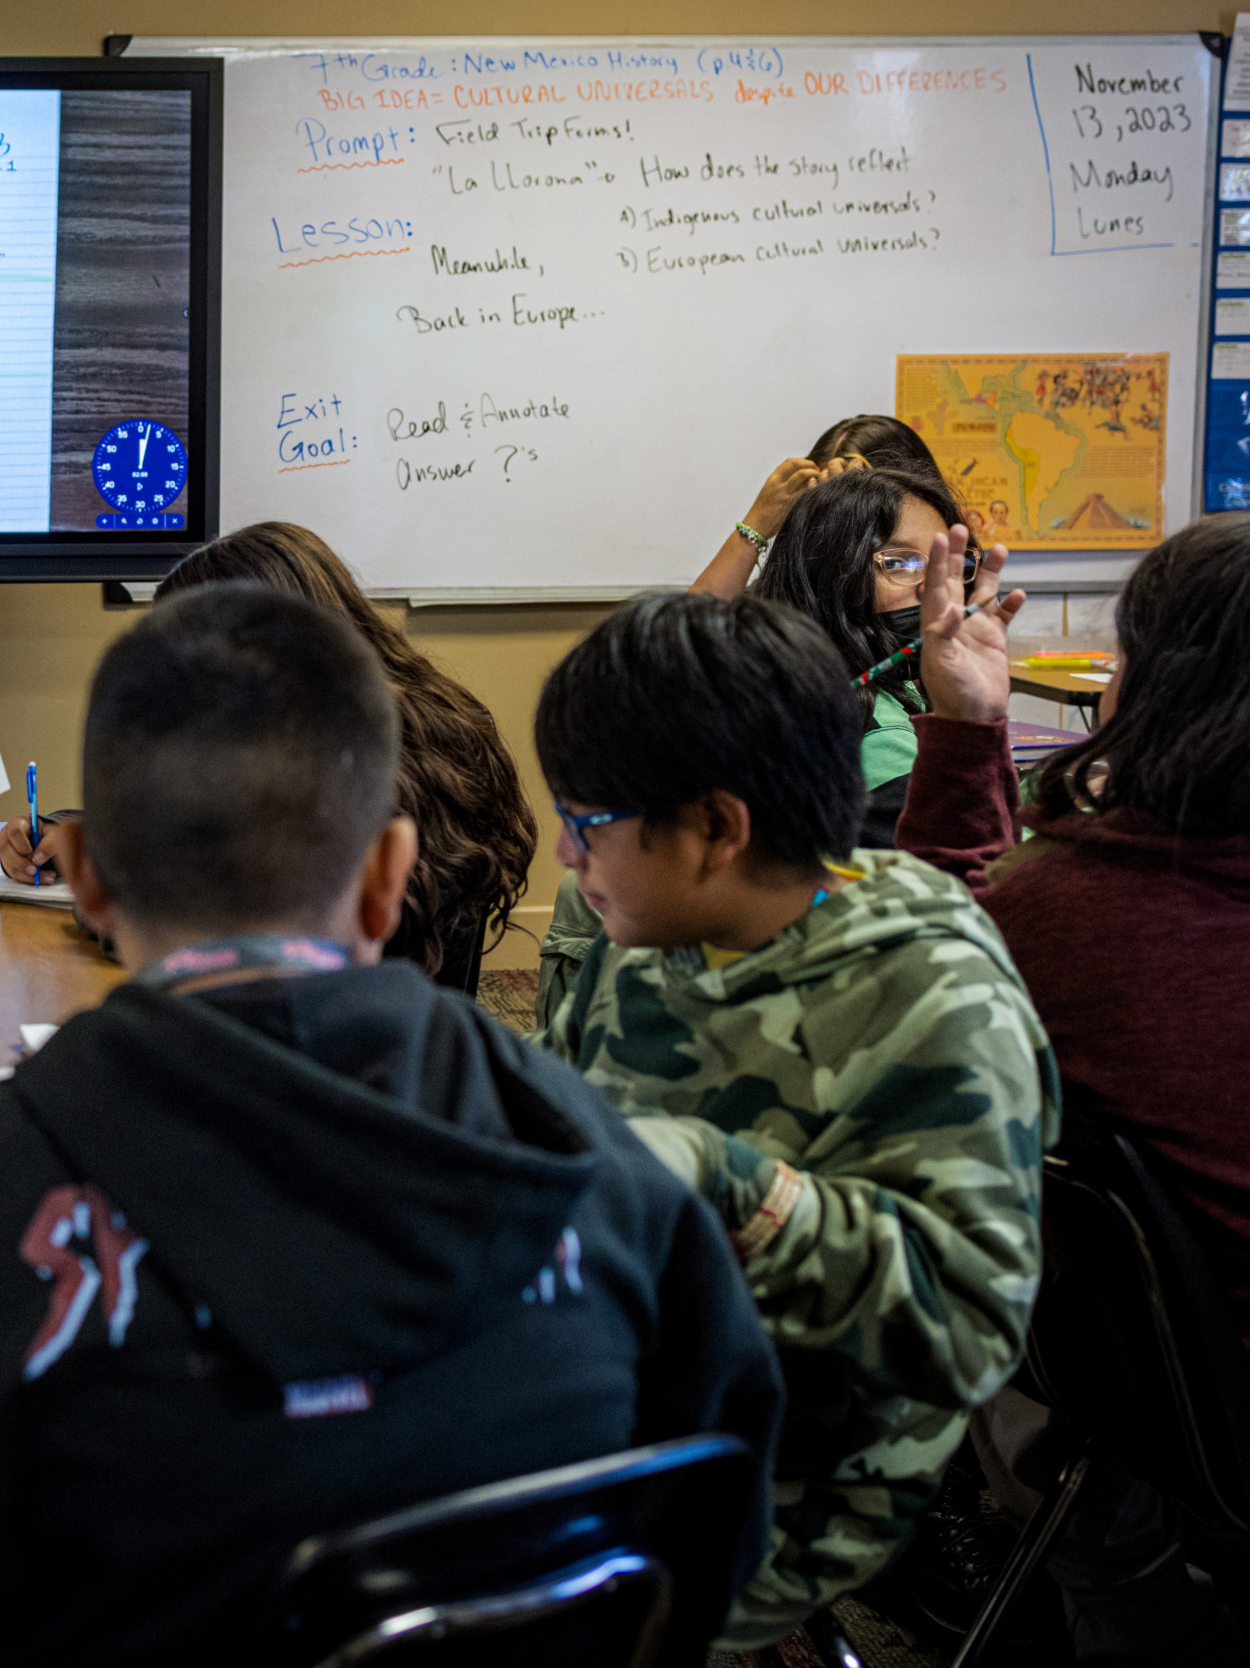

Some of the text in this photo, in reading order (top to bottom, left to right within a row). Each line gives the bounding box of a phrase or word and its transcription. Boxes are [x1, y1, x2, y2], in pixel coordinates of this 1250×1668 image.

[464, 52, 516, 74] New
[523, 50, 599, 70] Mexico
[607, 51, 679, 76] History
[1074, 61, 1185, 96] November
[316, 88, 366, 112] BIG
[453, 84, 566, 110] CULTURAL
[576, 79, 715, 103] UNIVERSALS
[803, 71, 850, 96] OUR
[855, 67, 1008, 95] DIFFERENCES
[435, 117, 500, 145] Field
[639, 154, 690, 188] How
[699, 152, 746, 182] does
[752, 154, 780, 178] the
[788, 154, 840, 191] story
[848, 146, 913, 174] reflect
[1068, 158, 1175, 204] Monday
[270, 216, 414, 254] Lesson:
[641, 206, 741, 237] Indigenous
[1077, 206, 1145, 240] Lunes
[646, 245, 747, 277] European
[396, 304, 468, 334] Back
[479, 307, 502, 325] in
[276, 392, 343, 430] Exit
[386, 400, 451, 442] Read
[479, 391, 571, 428] Annotate
[117, 430, 162, 439] 55 5
[137, 425, 145, 433] 0
[106, 444, 177, 453] 50 10
[278, 427, 358, 464] Goal:
[101, 462, 180, 471] 45 15
[104, 480, 176, 489] 40 20
[116, 494, 164, 503] 35 25
[134, 500, 146, 509] 30
